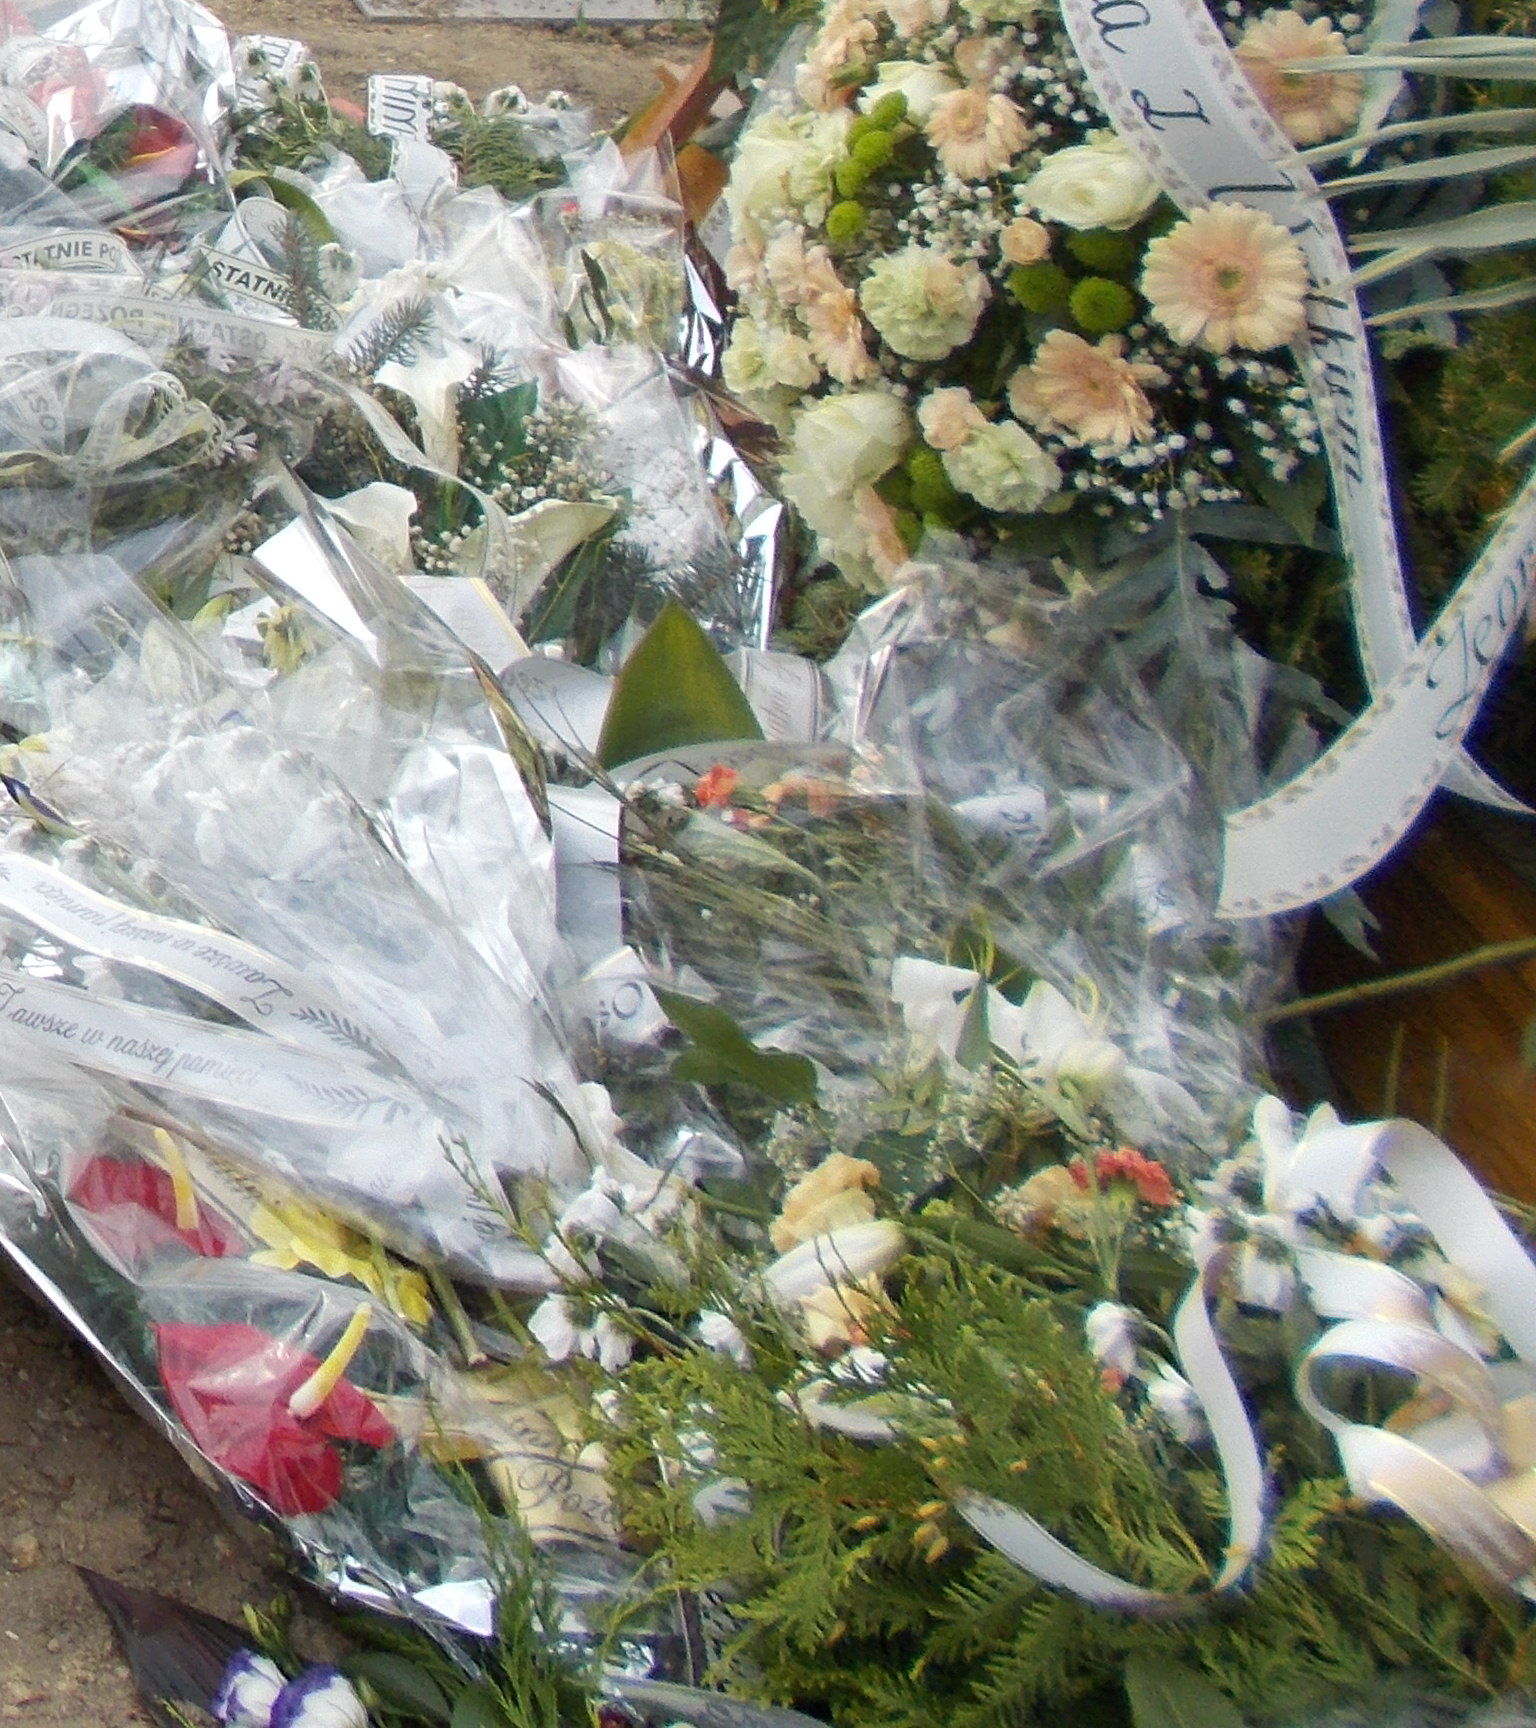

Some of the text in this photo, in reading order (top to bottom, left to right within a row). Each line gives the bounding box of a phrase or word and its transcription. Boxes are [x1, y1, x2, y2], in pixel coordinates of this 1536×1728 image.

[194, 946, 294, 1017] Zawsze
[81, 1026, 105, 1049] w
[106, 1032, 176, 1077] naszej
